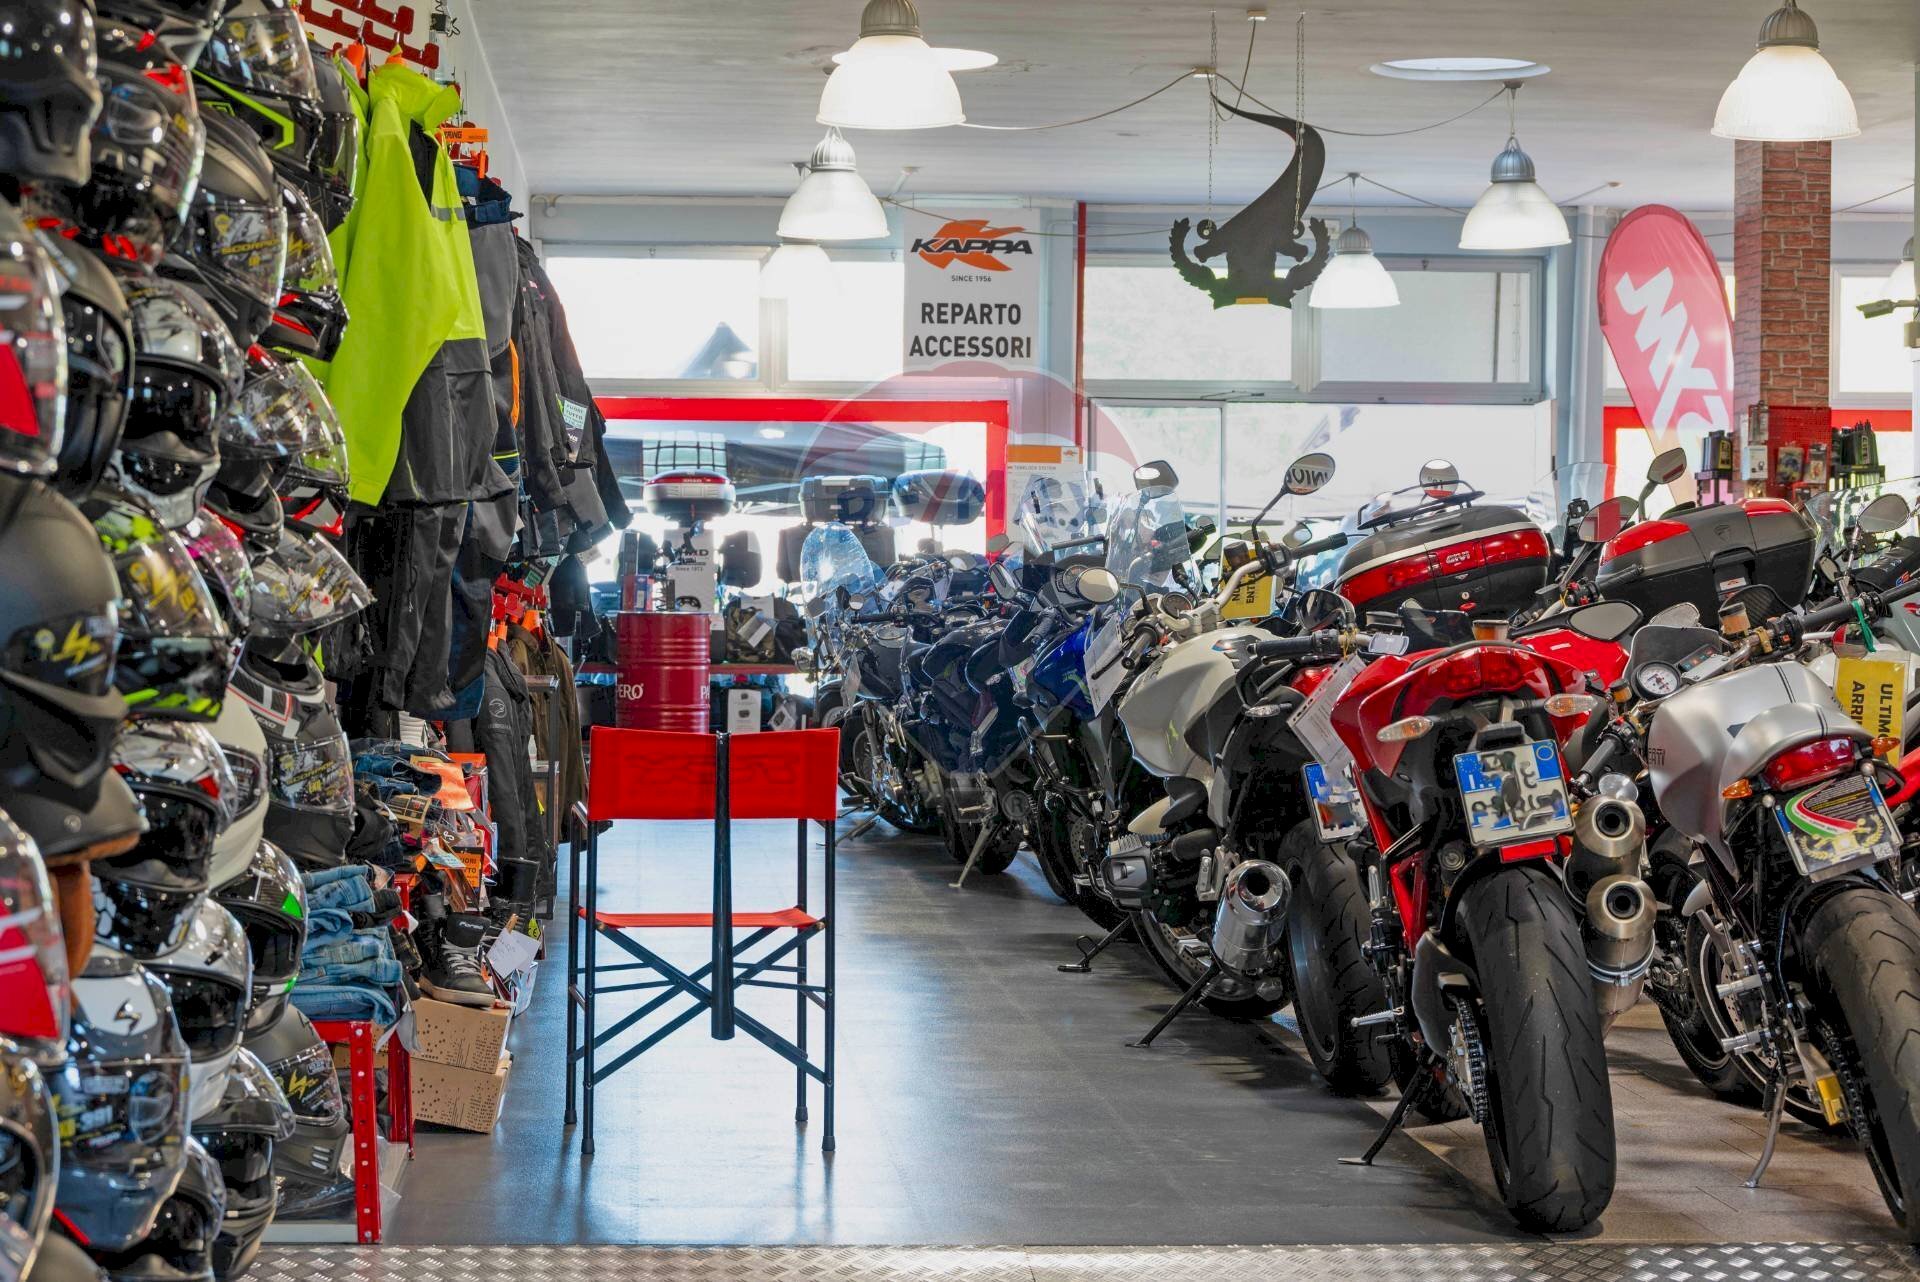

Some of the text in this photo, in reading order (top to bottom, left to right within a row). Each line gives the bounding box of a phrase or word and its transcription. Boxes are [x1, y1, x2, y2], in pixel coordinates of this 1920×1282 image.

[910, 238, 1033, 254] KAPPA
[951, 275, 992, 283] SINCE 1956
[921, 302, 1022, 325] REPARTO
[909, 335, 1032, 358] ACCESSORI
[1851, 680, 1865, 726] ARRI
